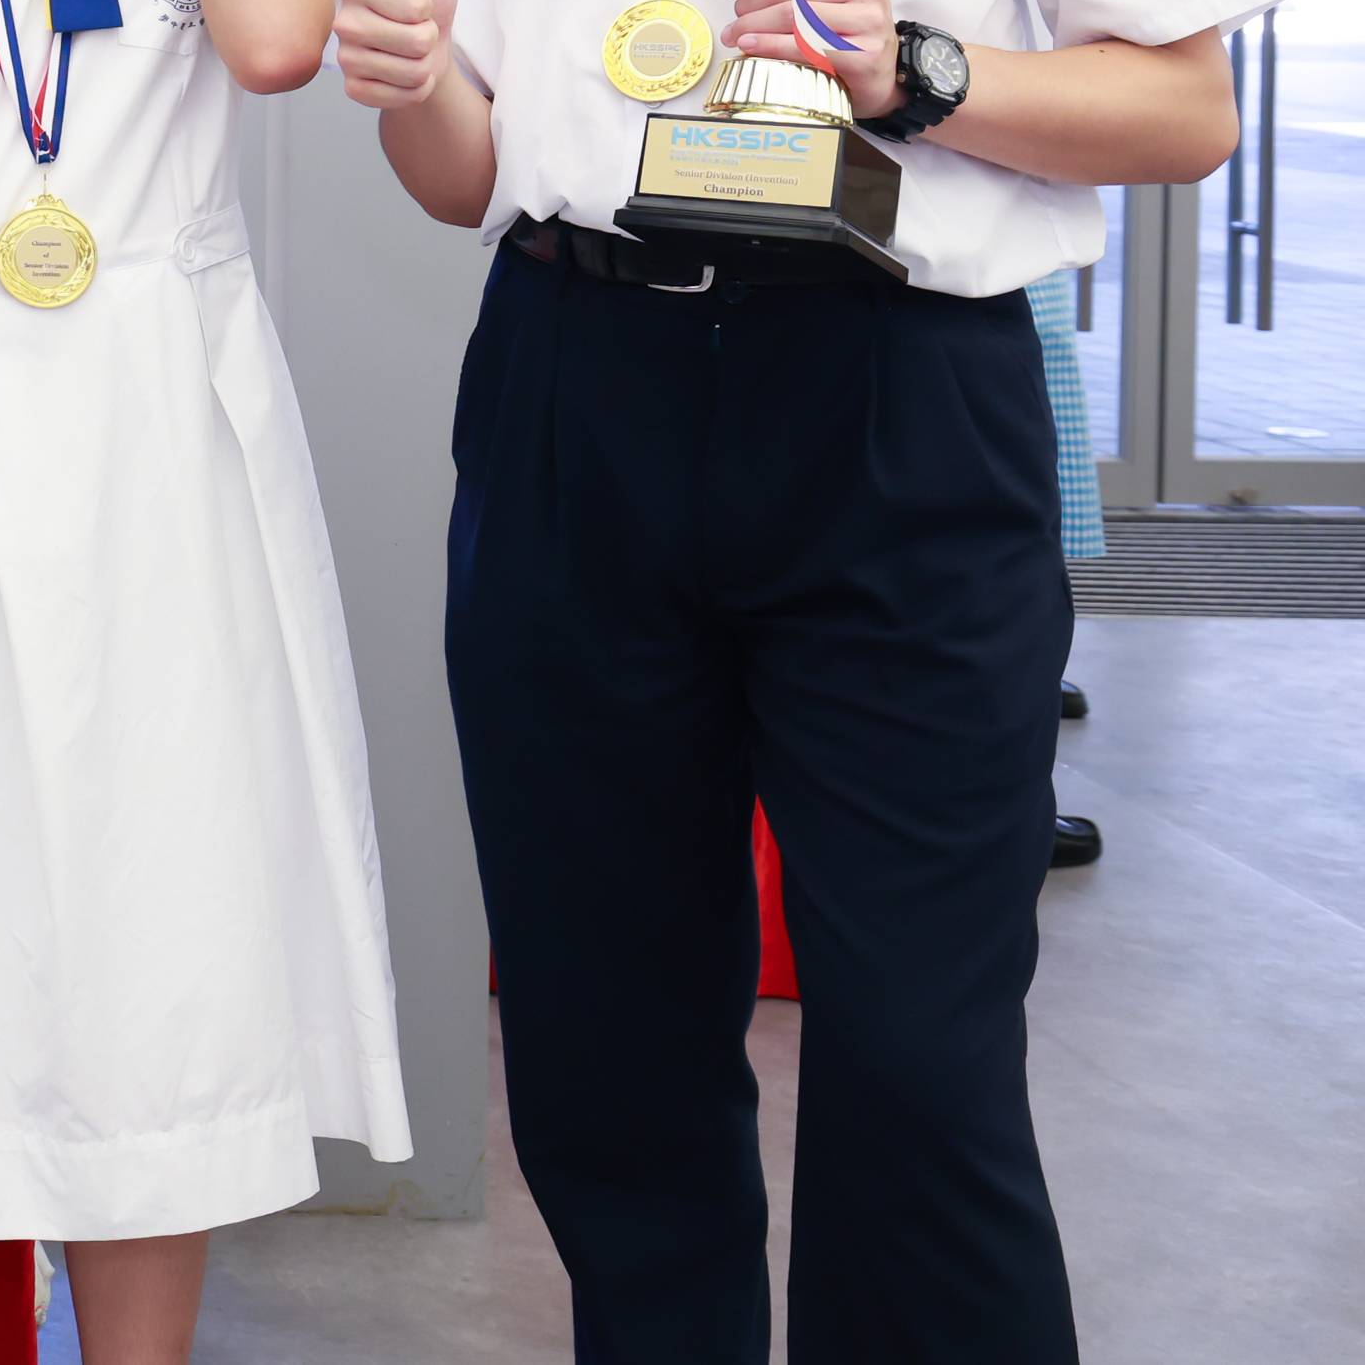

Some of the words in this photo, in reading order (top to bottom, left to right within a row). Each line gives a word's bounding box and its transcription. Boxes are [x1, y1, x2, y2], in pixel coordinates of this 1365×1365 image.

[671, 125, 811, 153] HKSSPC
[675, 169, 703, 179] Senior
[706, 170, 743, 181] Division
[745, 174, 798, 185] (Invention)
[704, 183, 764, 197] Champion
